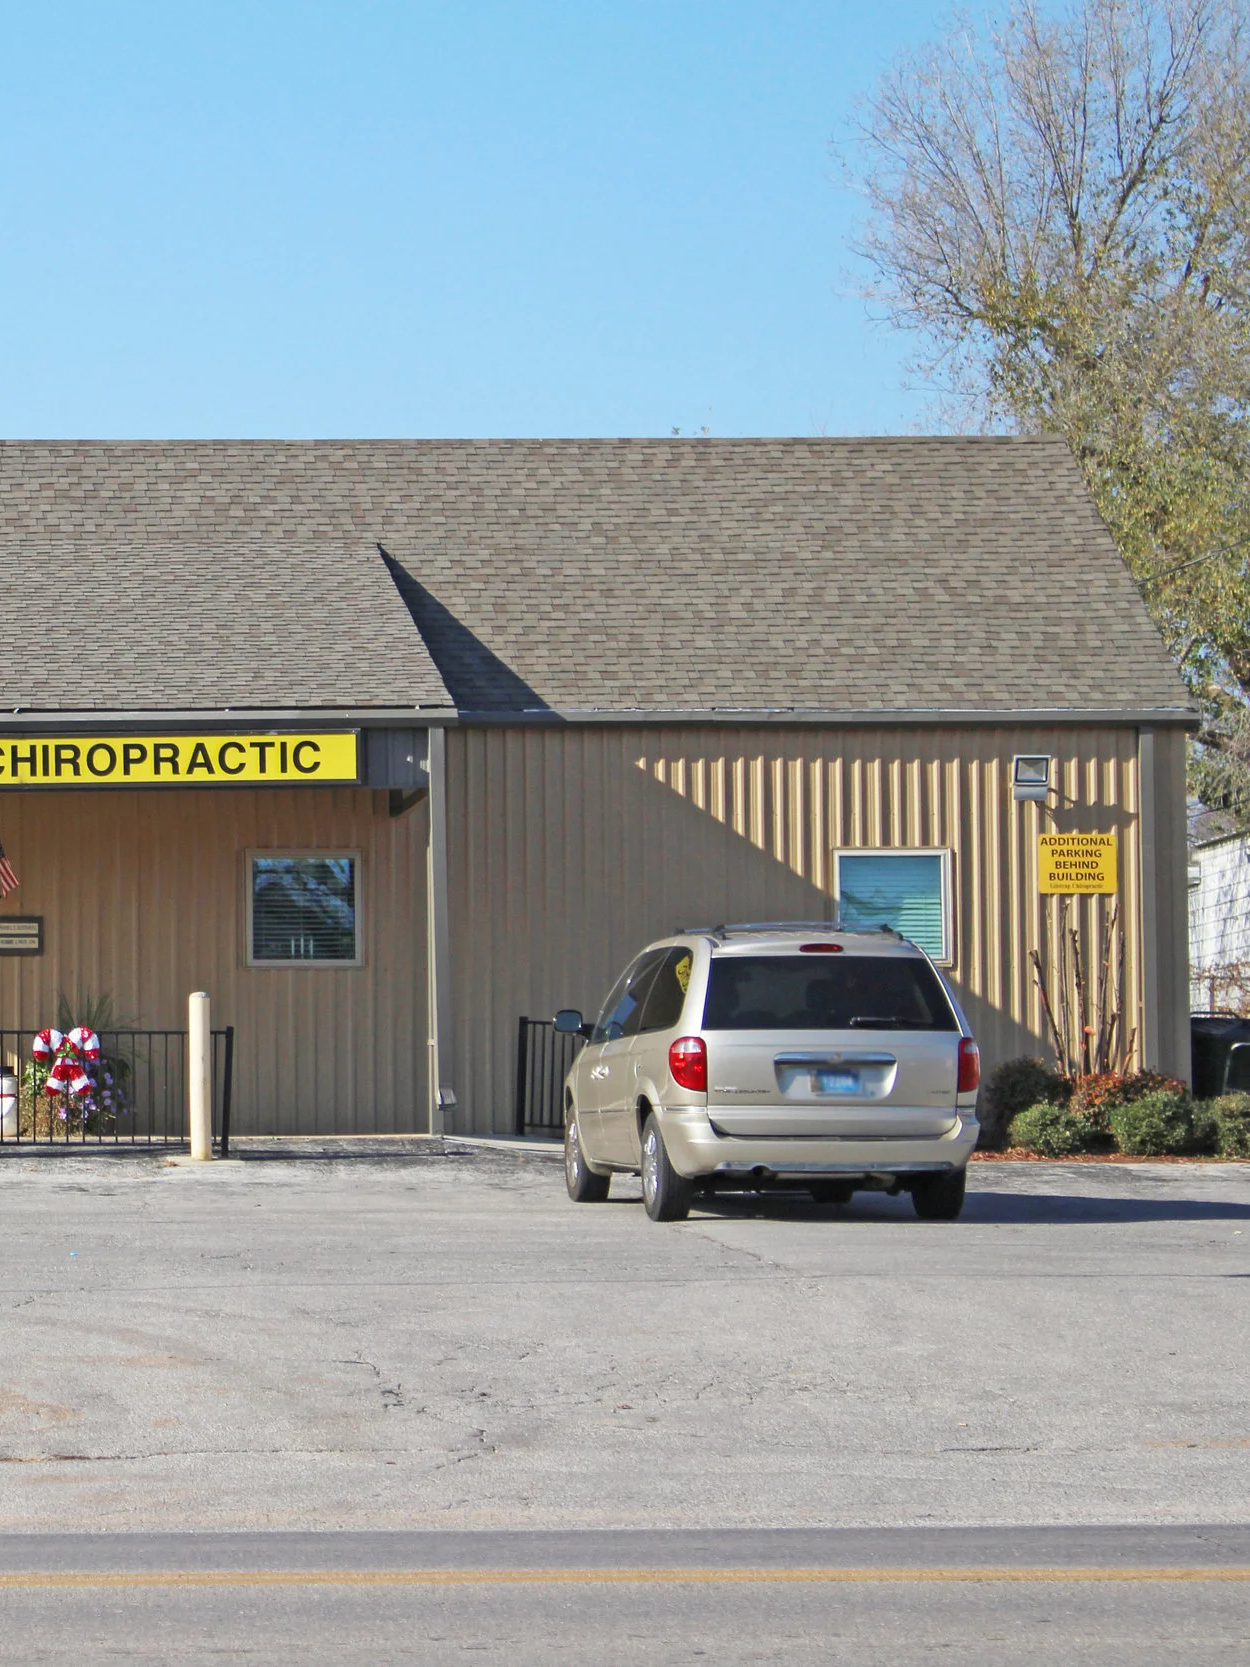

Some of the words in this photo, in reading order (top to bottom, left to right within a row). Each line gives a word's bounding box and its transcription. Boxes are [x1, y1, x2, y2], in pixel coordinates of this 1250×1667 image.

[1040, 837, 1113, 846] ADDITIONAL
[1051, 849, 1102, 858] PARKING
[1055, 861, 1099, 869] BEHIND
[1049, 872, 1105, 881] BUILDING
